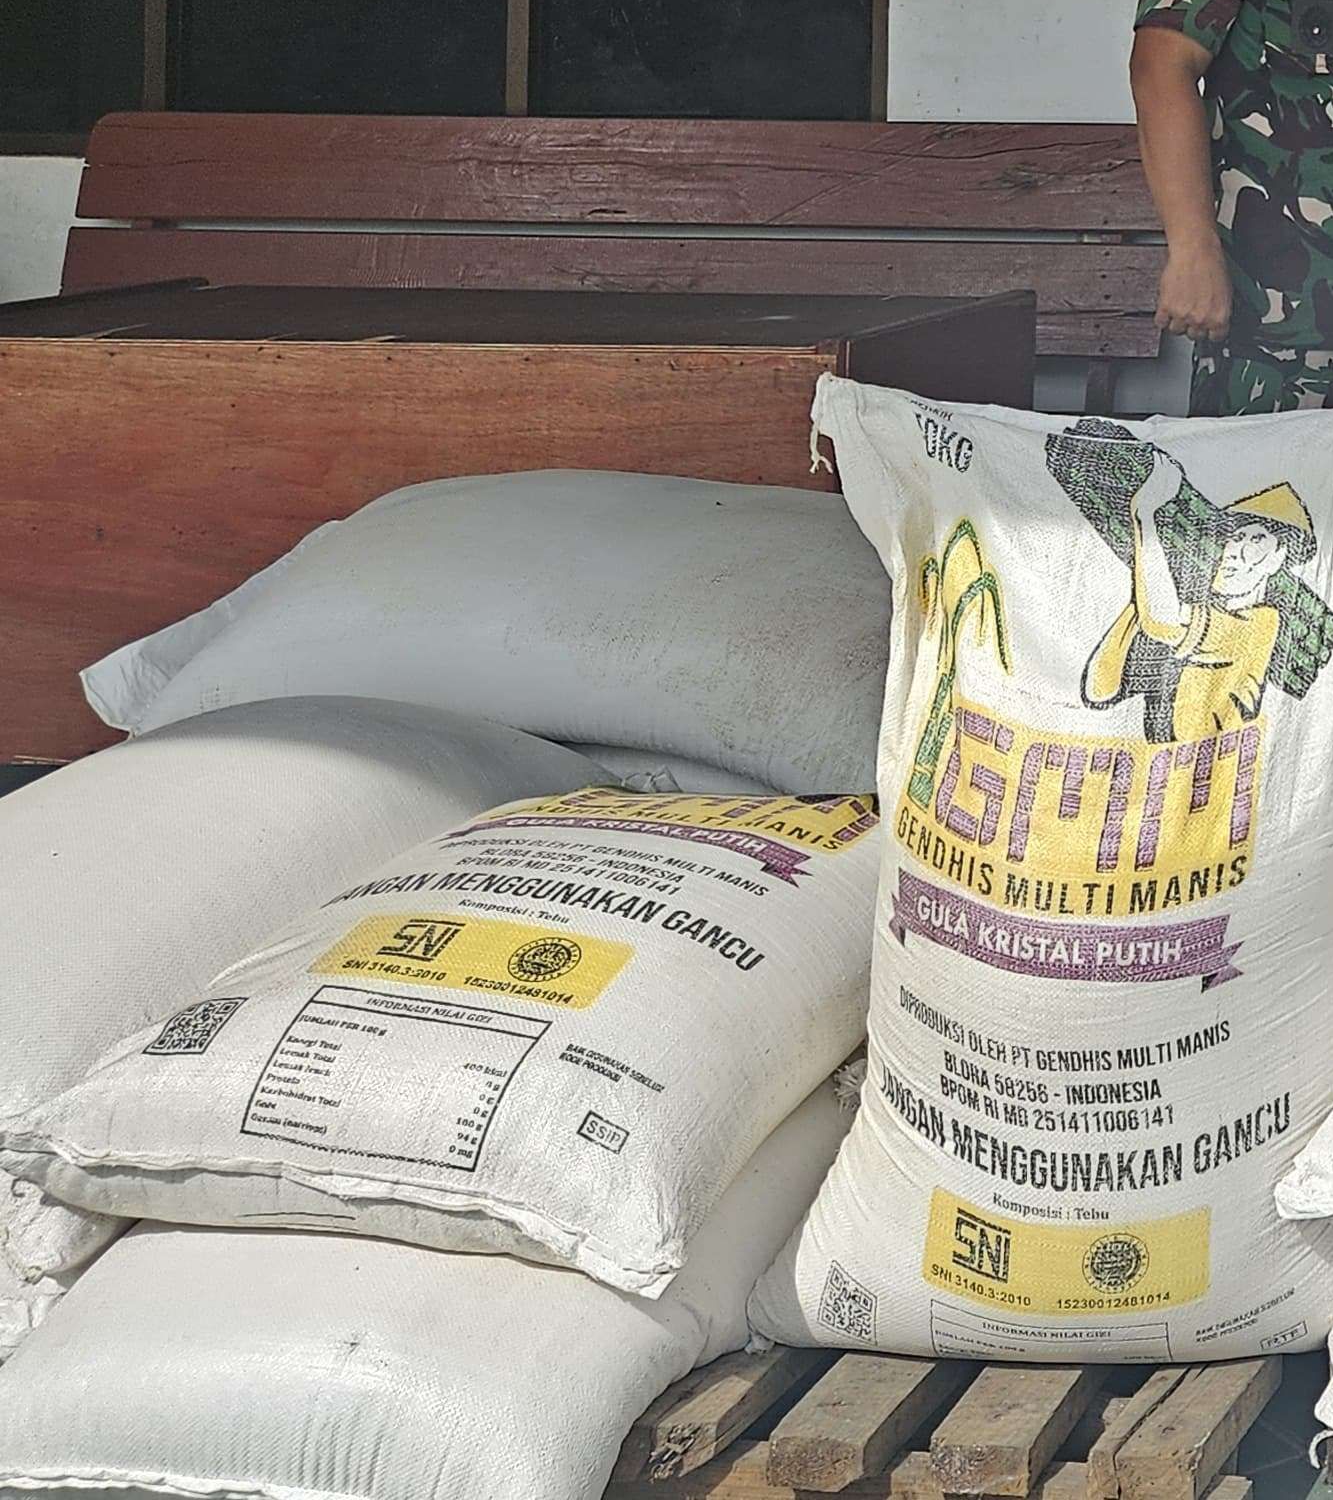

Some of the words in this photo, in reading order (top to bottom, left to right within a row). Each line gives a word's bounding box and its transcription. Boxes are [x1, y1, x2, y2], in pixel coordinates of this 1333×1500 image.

[663, 856, 718, 877] MULTI
[716, 871, 771, 898] MANIS
[897, 806, 995, 897] GENDHIS
[1004, 873, 1115, 915] MULTI
[1128, 855, 1248, 915] MANIS
[376, 918, 465, 963] SNI
[433, 871, 666, 924] MENGGUNAKAN
[661, 907, 767, 973] GANCU
[916, 896, 970, 940] GULA
[978, 918, 1086, 966] KRISTAL
[1096, 937, 1183, 967] PUTIH
[900, 985, 965, 1047] DIPRODUKSI
[968, 1029, 1008, 1064] OLEH
[1012, 1046, 1031, 1068] PT
[1036, 1050, 1112, 1072] GENDHIS
[1117, 1042, 1172, 1070] MULTI
[1176, 1020, 1231, 1059] MANIS
[943, 1050, 990, 1091] BLORA
[1065, 1078, 1162, 1105] INDONESIA
[880, 1065, 947, 1148] JANGAN
[951, 1118, 1182, 1193] MENGGUNAKAN
[1193, 1092, 1291, 1175] GANCU
[953, 1212, 1011, 1283] SNI
[930, 1263, 952, 1283] SNI
[955, 1274, 1032, 1307] 3140.3:2010
